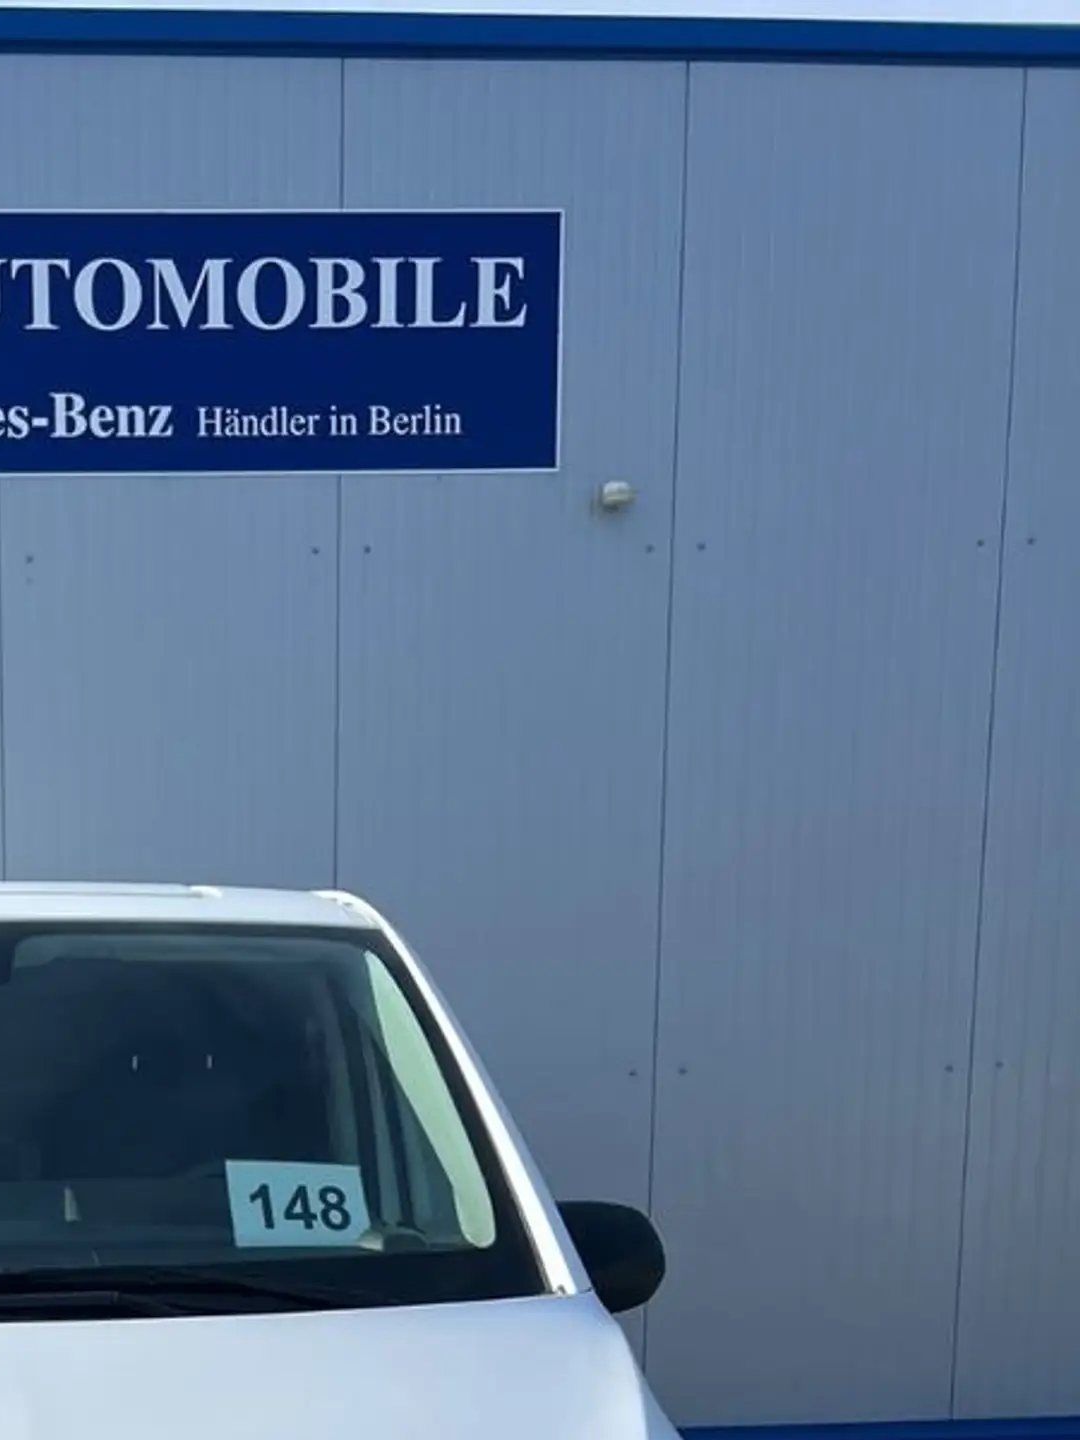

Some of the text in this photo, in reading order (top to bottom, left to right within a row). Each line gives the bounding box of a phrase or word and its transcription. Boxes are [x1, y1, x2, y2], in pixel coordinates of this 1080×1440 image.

[197, 405, 321, 437] Händler
[329, 405, 358, 436] in
[368, 403, 463, 436] Berlin
[249, 1183, 351, 1231] 148
